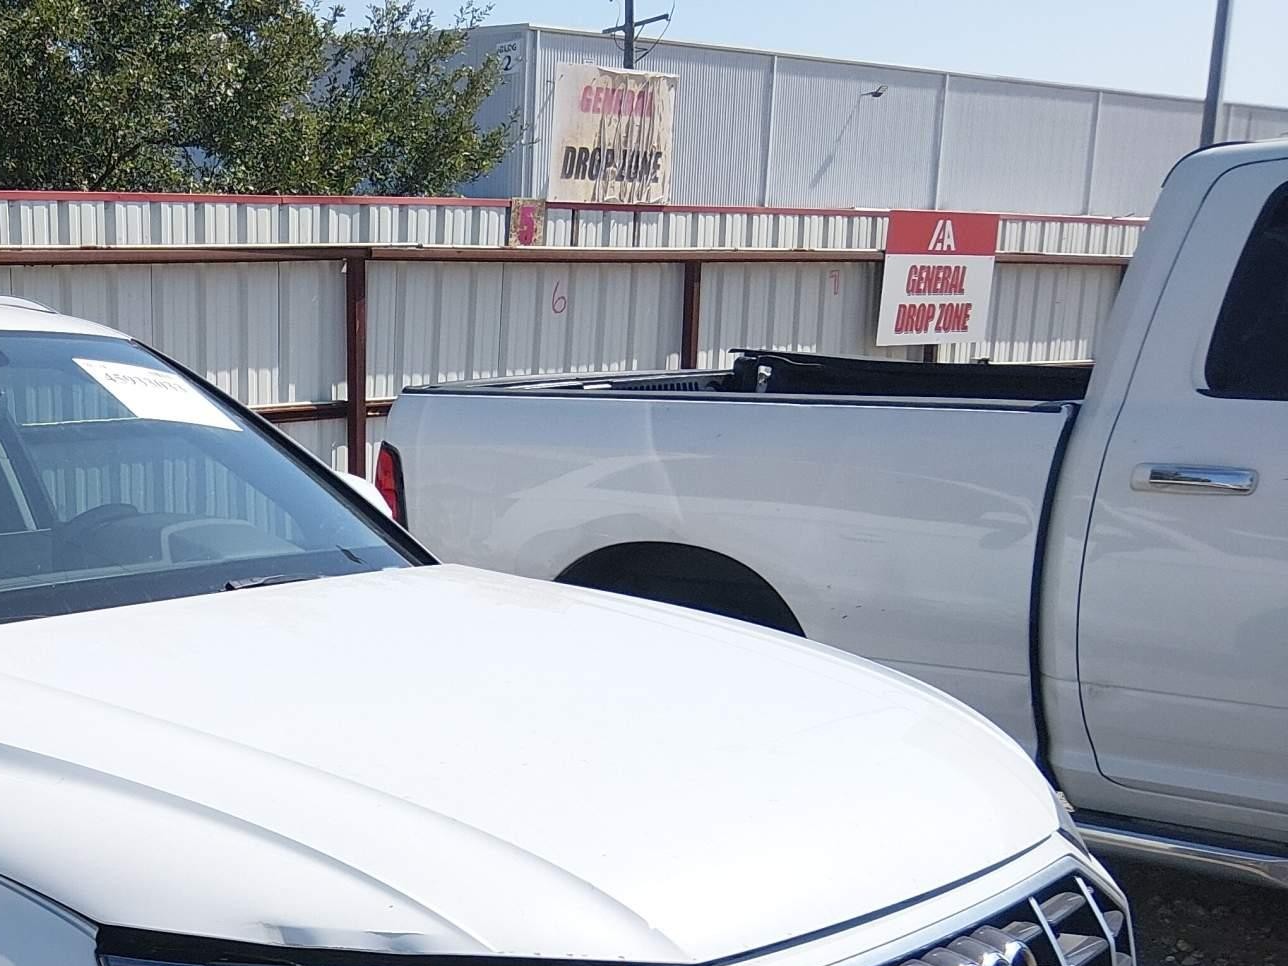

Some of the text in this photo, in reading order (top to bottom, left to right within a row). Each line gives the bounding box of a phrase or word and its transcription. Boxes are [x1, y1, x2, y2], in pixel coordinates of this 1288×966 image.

[561, 146, 616, 180] DROP
[518, 205, 536, 245] 5
[552, 280, 566, 314] 6
[906, 265, 968, 296] GENERAL
[894, 302, 972, 335] DROP ZONE
